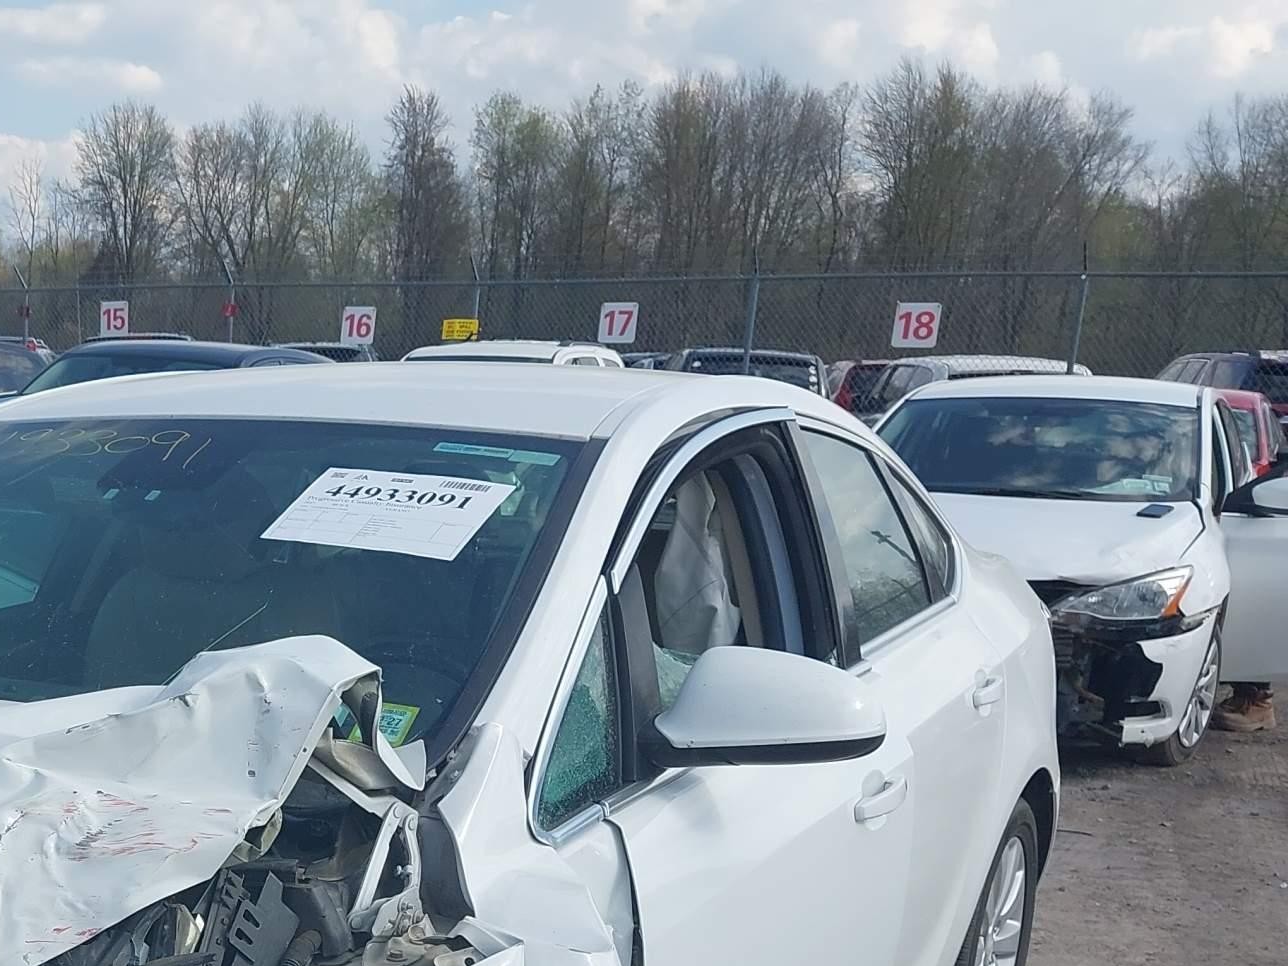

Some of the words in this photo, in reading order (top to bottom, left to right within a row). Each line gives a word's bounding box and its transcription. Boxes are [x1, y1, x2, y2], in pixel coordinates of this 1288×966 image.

[103, 308, 126, 331] 15
[344, 313, 372, 338] 16
[604, 310, 634, 337] 17
[899, 311, 935, 340] 18
[325, 484, 473, 510] 44933091
